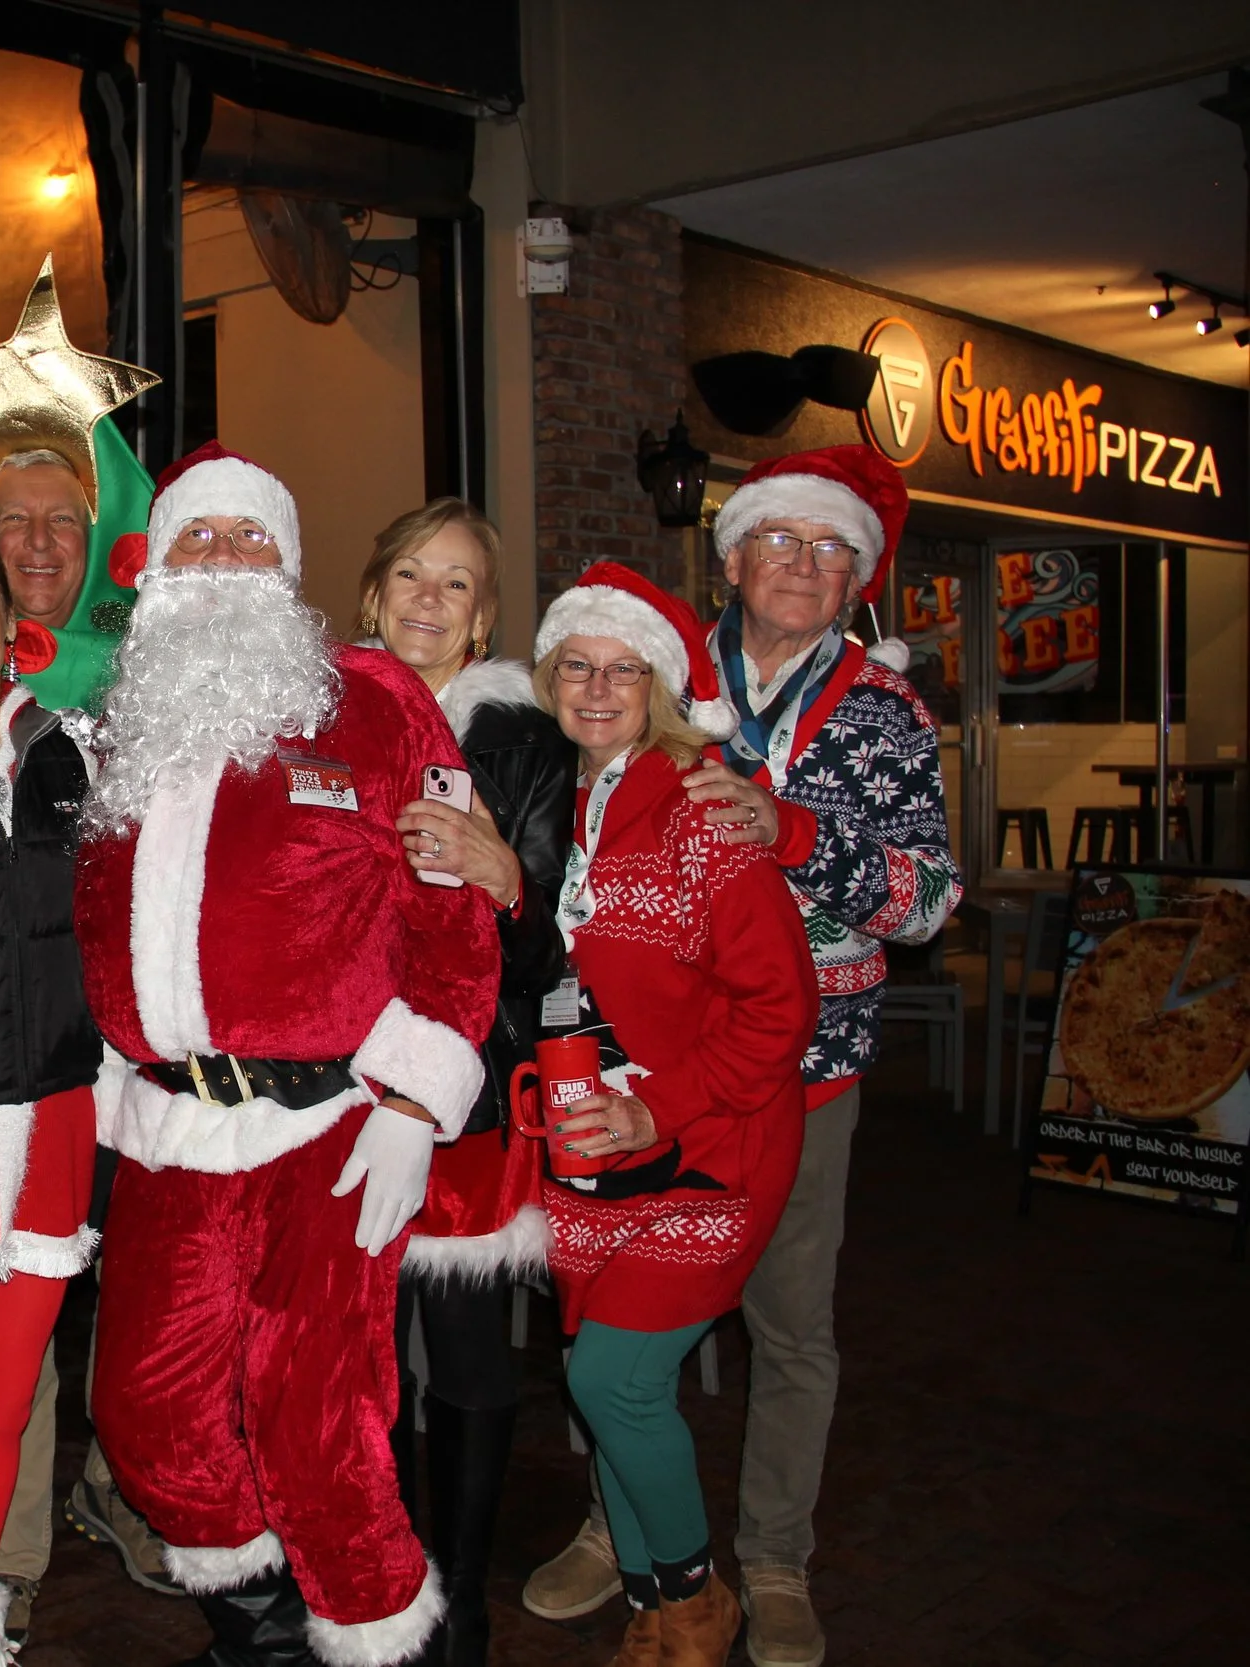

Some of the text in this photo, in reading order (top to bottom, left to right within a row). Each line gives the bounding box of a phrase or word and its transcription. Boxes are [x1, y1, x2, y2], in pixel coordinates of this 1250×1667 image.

[941, 341, 1222, 498] Graffiti PIZZA
[291, 773, 321, 784] 2025
[1081, 908, 1128, 923] PIZZA
[557, 1081, 587, 1095] BUD
[1088, 1130, 1106, 1145] AT
[1136, 1137, 1170, 1157] BAR
[1170, 1142, 1193, 1160] OR
